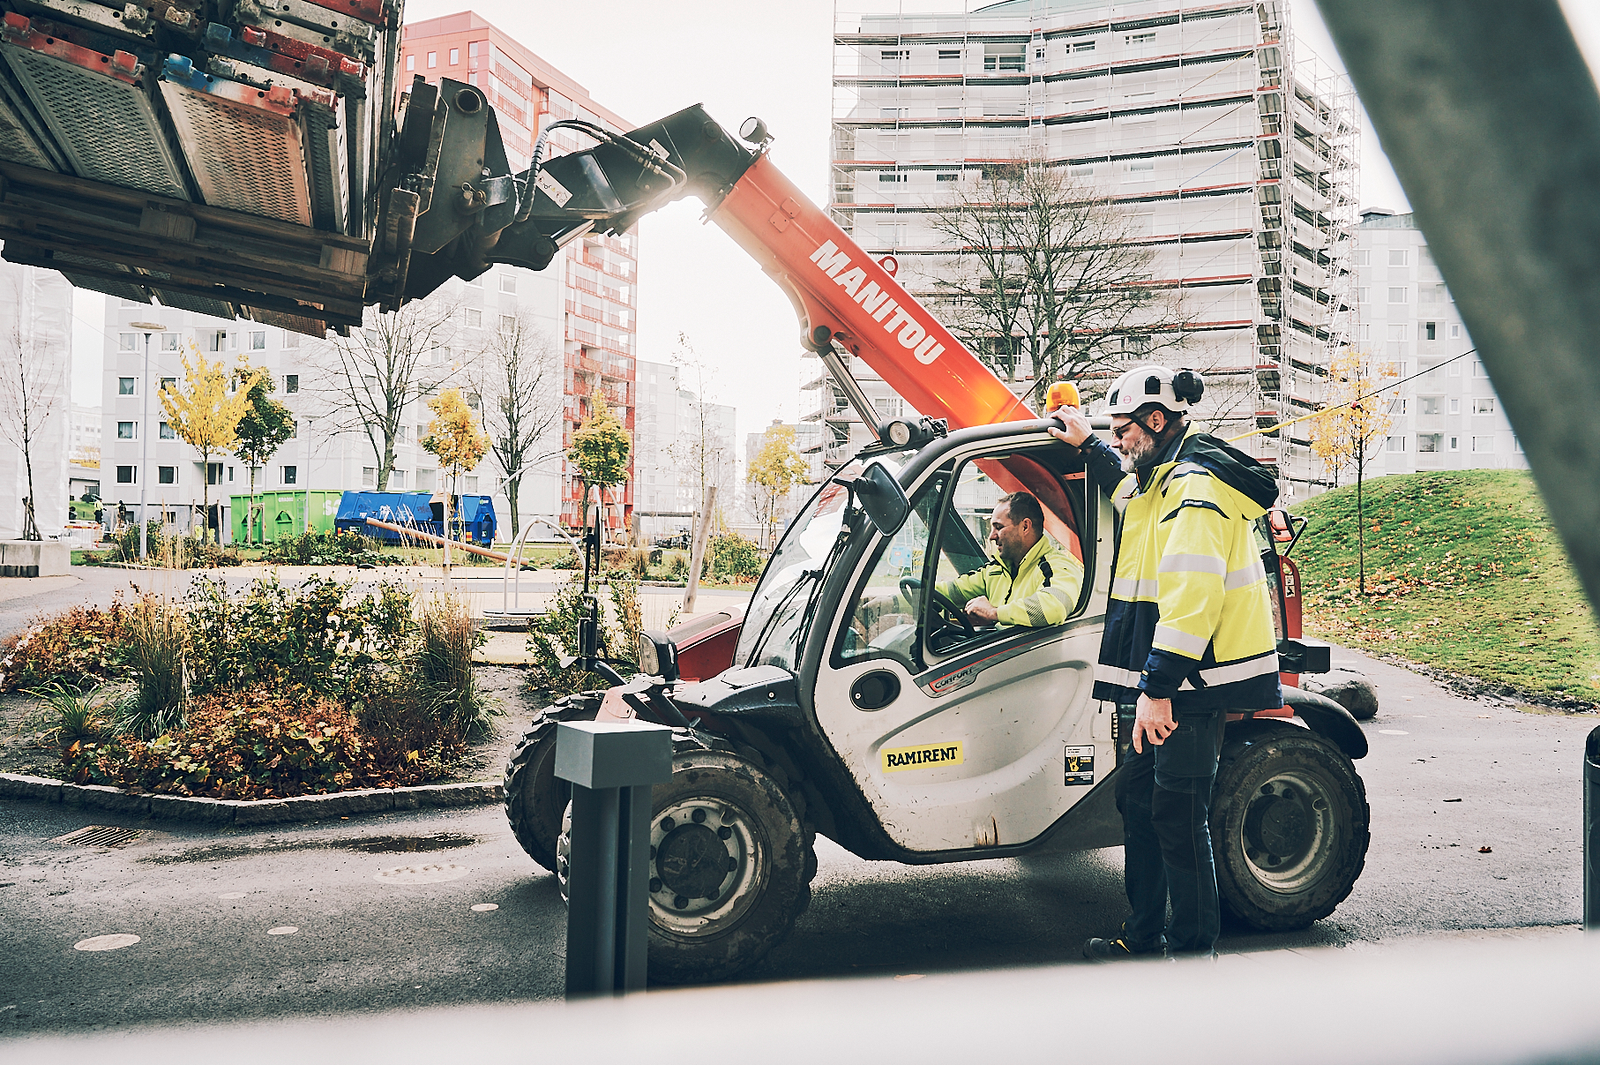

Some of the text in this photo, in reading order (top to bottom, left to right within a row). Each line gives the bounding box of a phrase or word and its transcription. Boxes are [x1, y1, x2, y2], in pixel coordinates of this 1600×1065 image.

[809, 239, 946, 365] MANITOU
[934, 666, 974, 689] COMFORT
[887, 747, 958, 767] RAMIRENT
